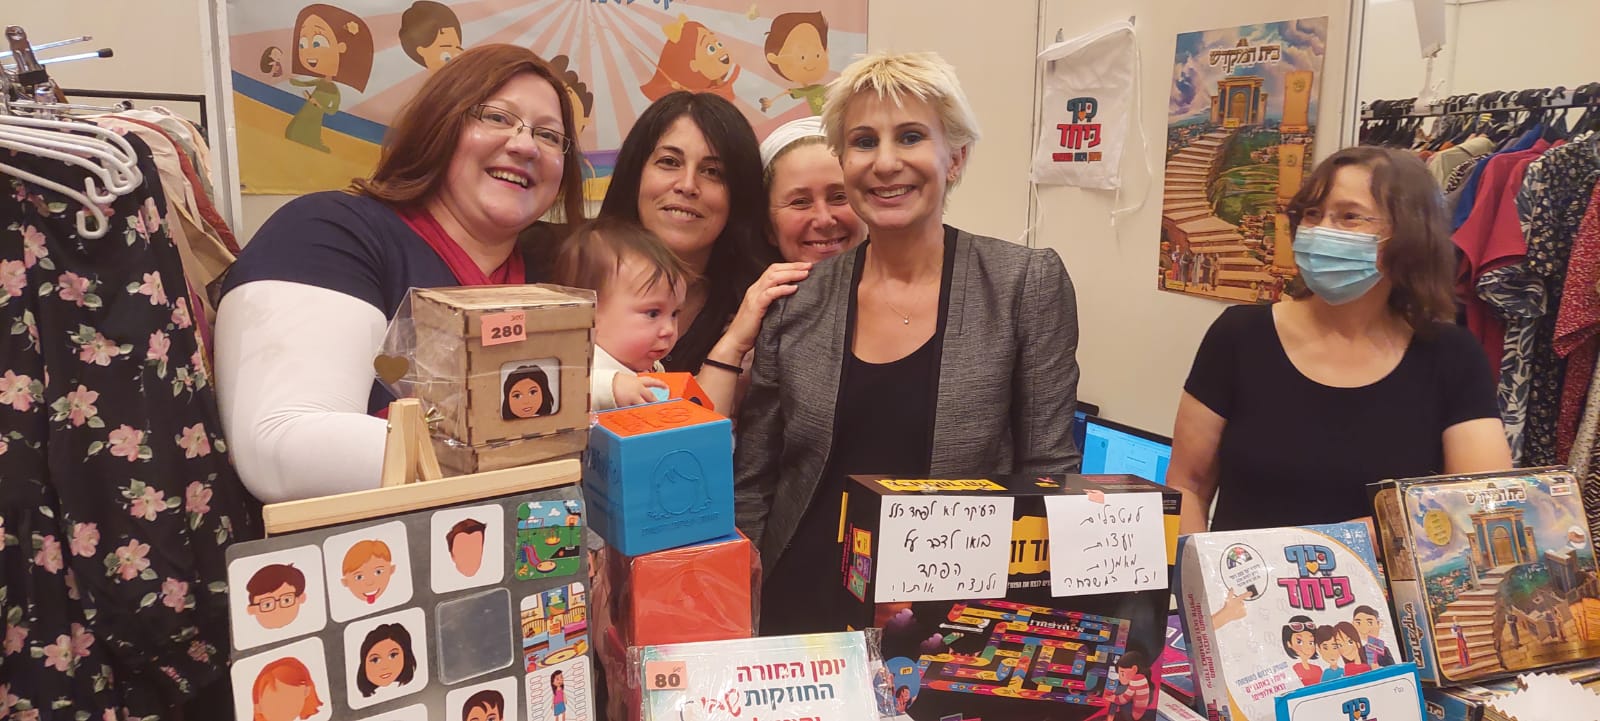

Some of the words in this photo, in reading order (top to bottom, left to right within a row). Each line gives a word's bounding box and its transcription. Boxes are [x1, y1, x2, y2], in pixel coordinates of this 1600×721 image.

[1210, 46, 1257, 73] המקדש
[1260, 44, 1280, 62] בית
[1066, 96, 1098, 124] כיף
[1056, 123, 1102, 150] ביחד
[491, 324, 523, 339] 280
[888, 502, 905, 519] כלל
[909, 500, 938, 521] לפחד
[943, 502, 960, 517] לא
[964, 503, 997, 521] העיקר
[1080, 504, 1144, 526] למטפלים
[904, 528, 919, 552] על
[926, 529, 962, 550] לדבר
[966, 534, 992, 550] בואו
[1083, 532, 1134, 552] יועצות
[917, 562, 962, 579] הפחד
[1086, 553, 1137, 574] מאמנות
[1284, 544, 1337, 577] כיף
[956, 573, 997, 593] ולנצח
[1064, 575, 1118, 588] המשפחה
[1134, 567, 1156, 585] וכל
[1277, 576, 1356, 610] ביחד
[655, 673, 680, 688] 80
[736, 661, 806, 682] המורה
[809, 658, 847, 682] יומן
[744, 683, 835, 711] החוזקות
[1342, 697, 1371, 721] כיף
